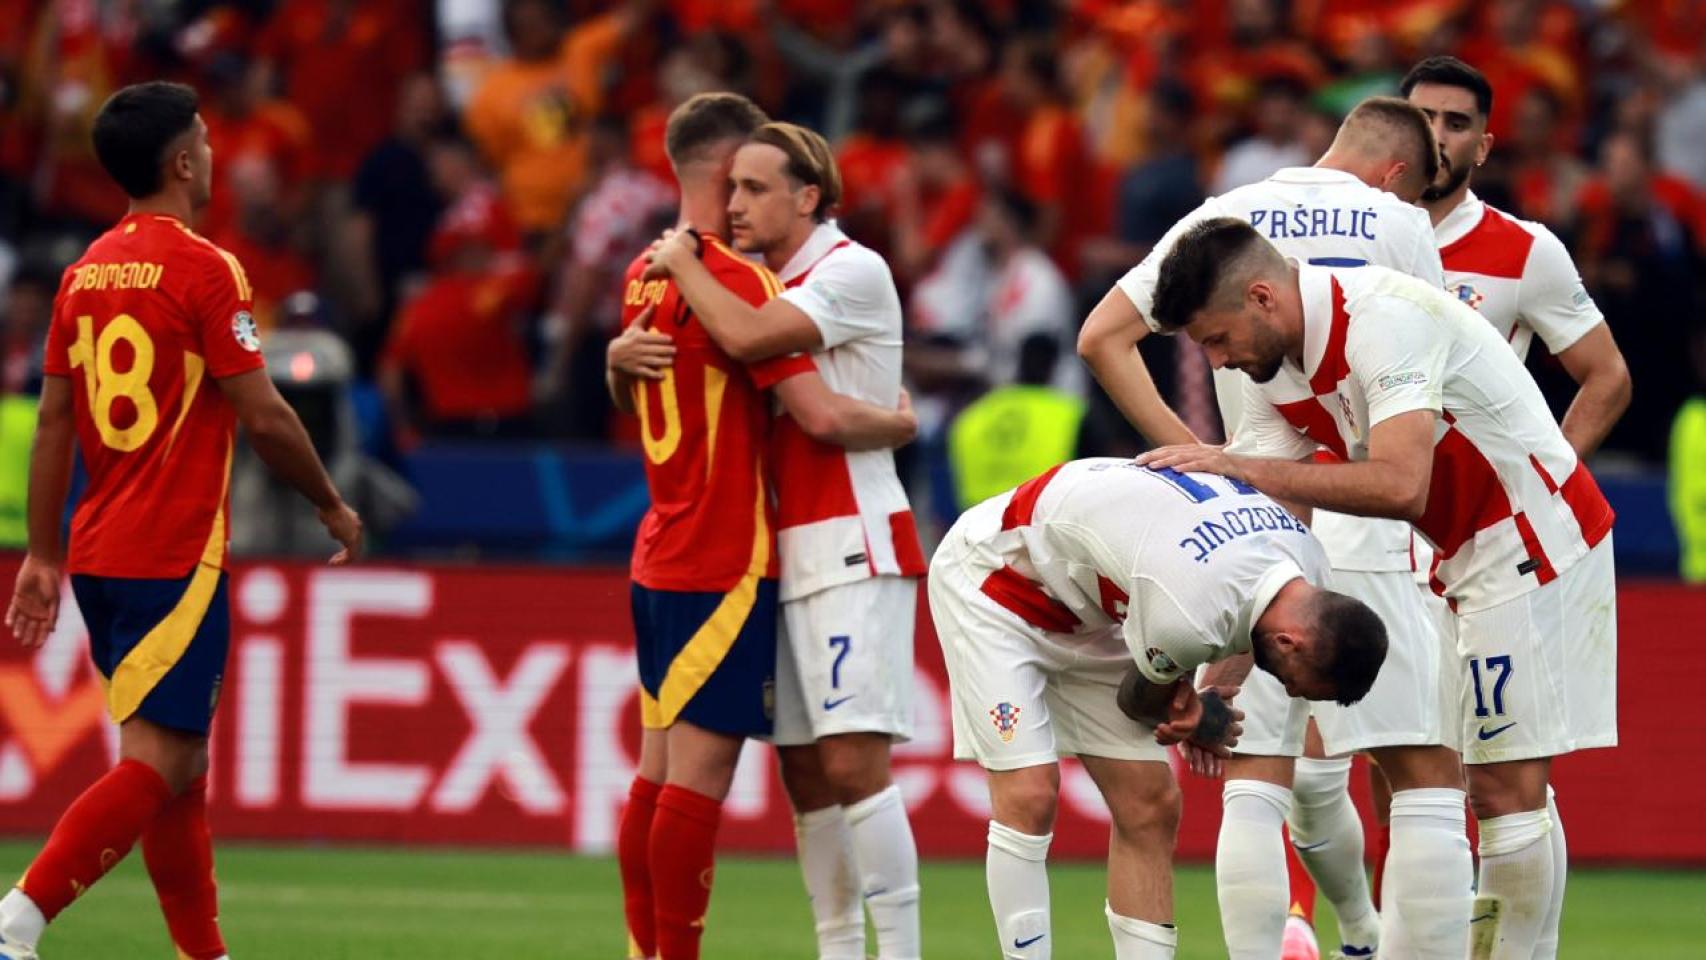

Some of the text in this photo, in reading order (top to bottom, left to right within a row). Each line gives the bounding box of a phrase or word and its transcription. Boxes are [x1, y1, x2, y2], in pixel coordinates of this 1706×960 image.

[1250, 203, 1378, 240] PAŠALIĆ
[67, 313, 159, 452] 18
[829, 635, 851, 689] 7
[1469, 655, 1514, 718] 17
